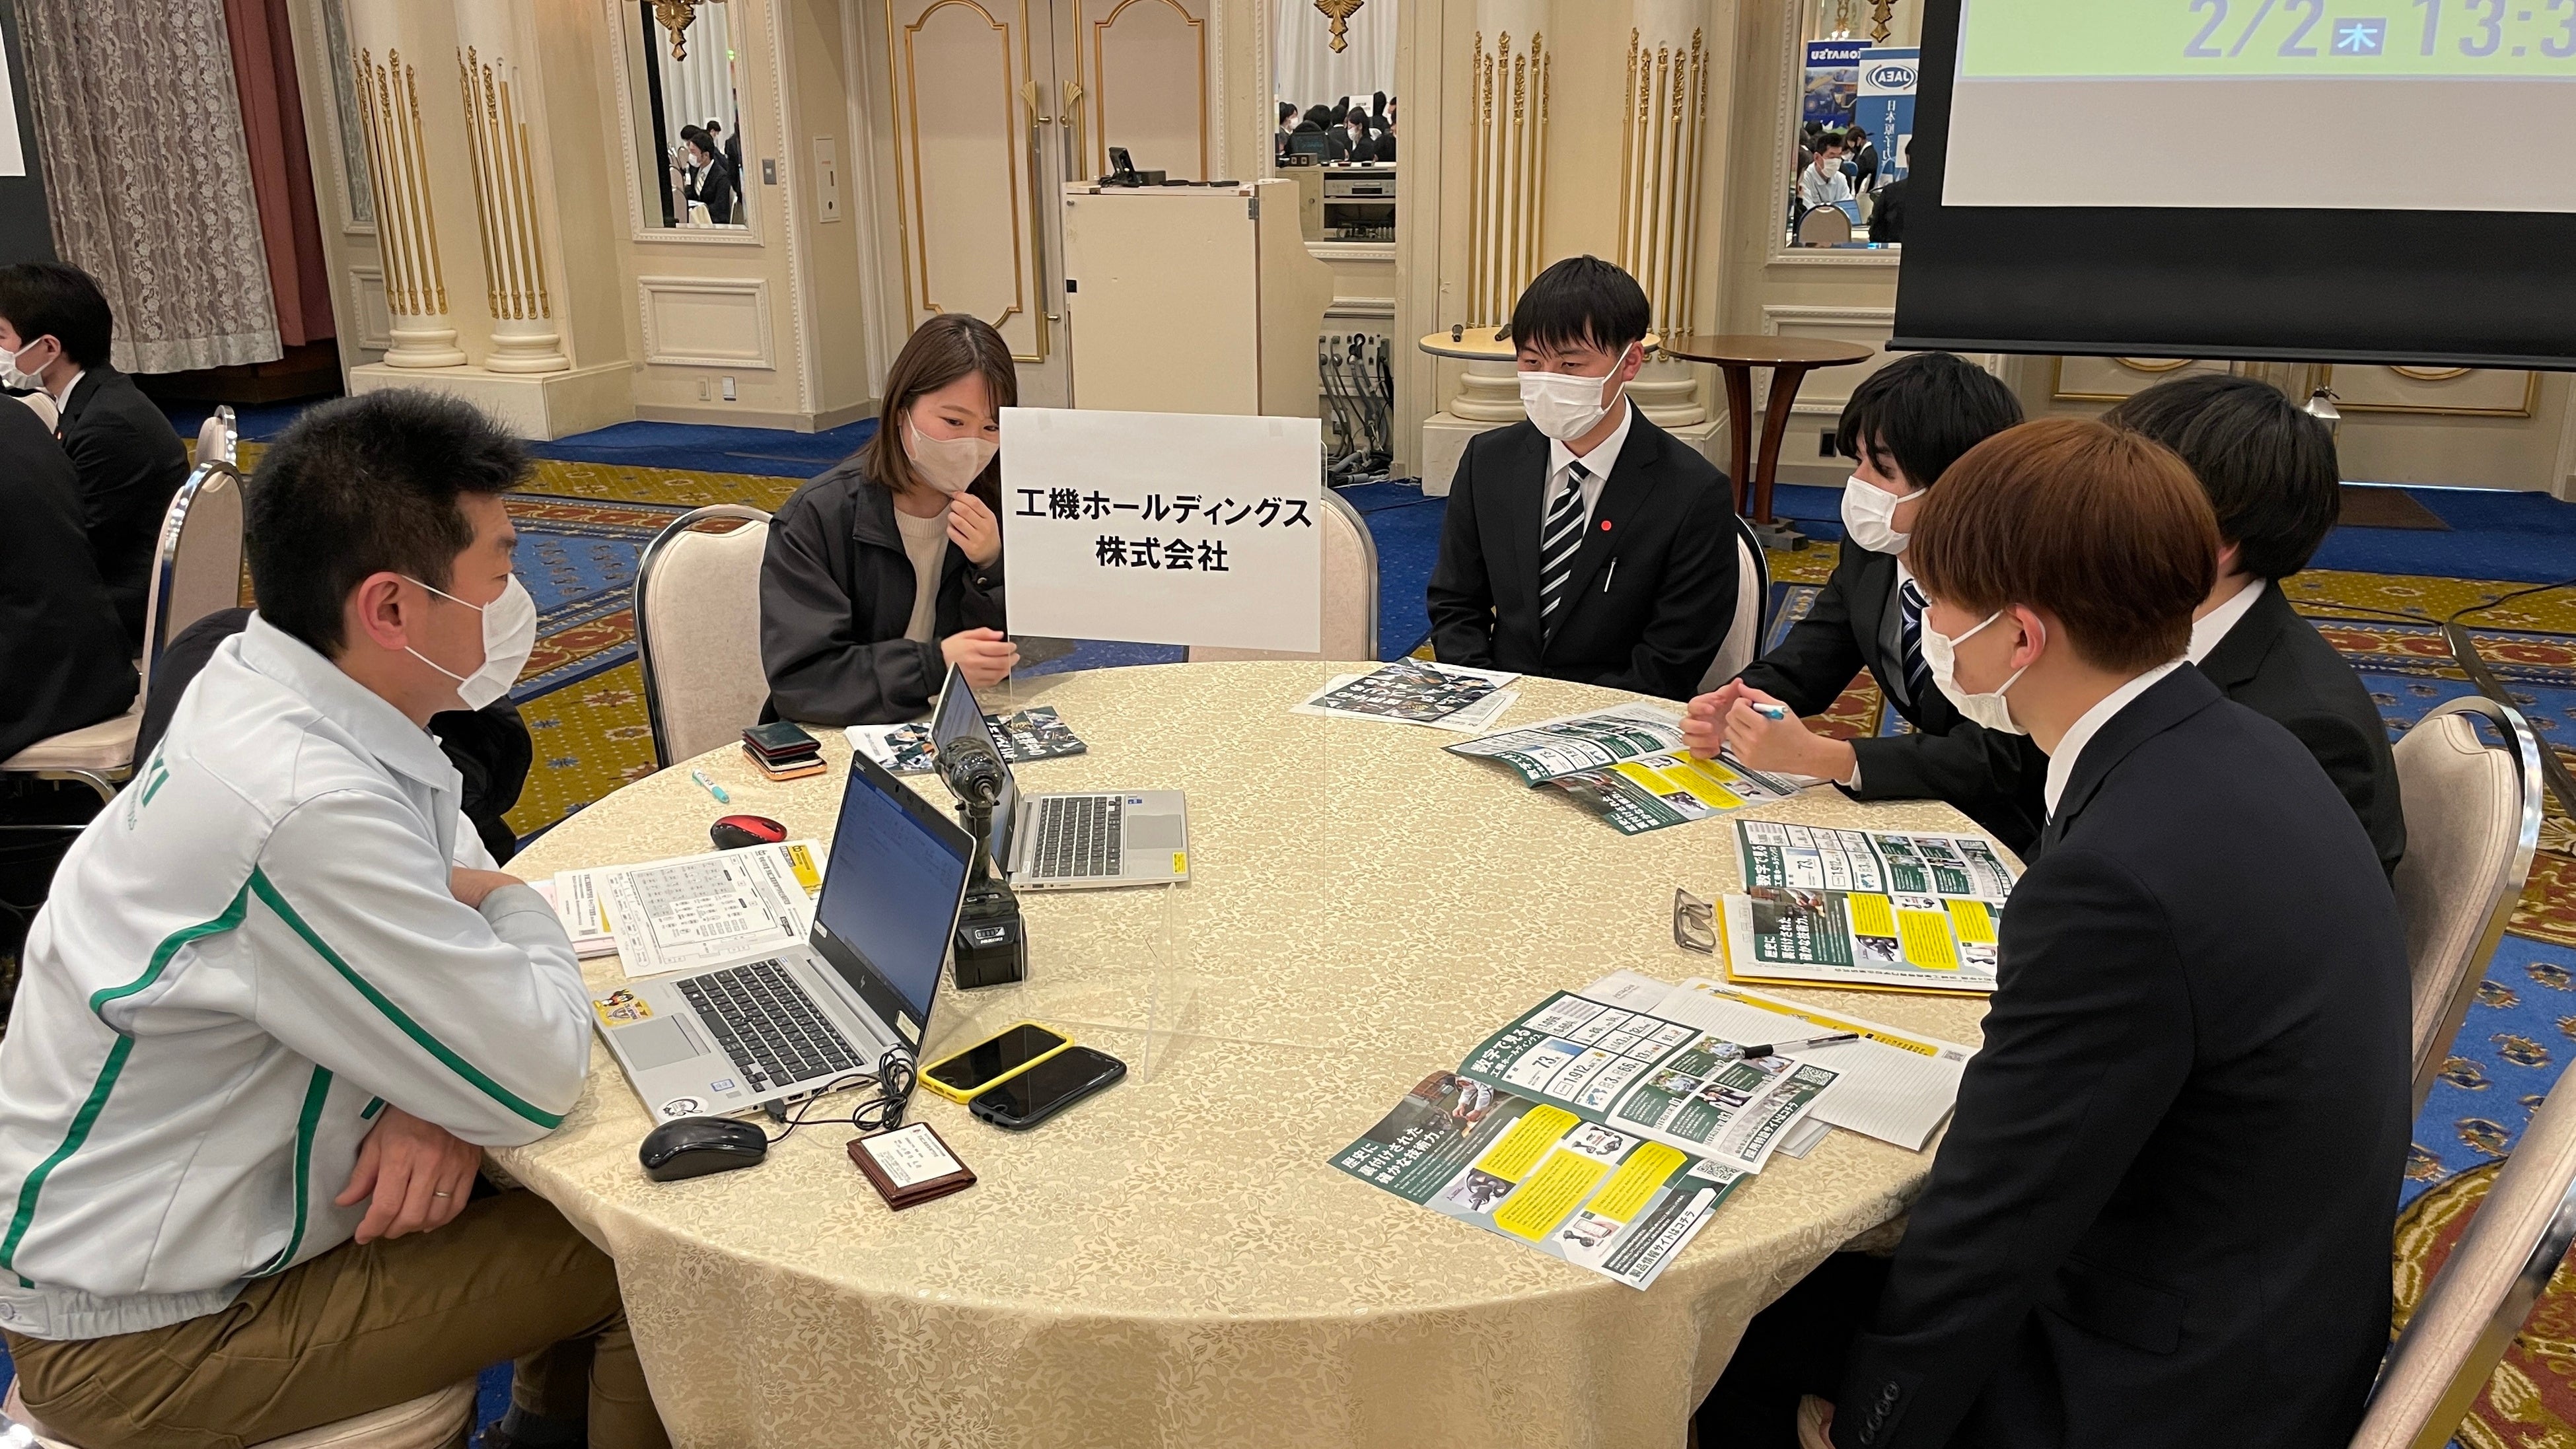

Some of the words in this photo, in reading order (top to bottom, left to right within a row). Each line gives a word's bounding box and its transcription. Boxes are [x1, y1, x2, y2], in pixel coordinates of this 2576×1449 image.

[2338, 23, 2378, 52] 木
[1015, 487, 1312, 528] 工機ホールディングス
[1095, 535, 1229, 572] 株式会社
[1013, 731, 1047, 756] 世界中の
[1752, 845, 1771, 886] 数字で見る
[1470, 1028, 1531, 1073] 数字で見る
[1341, 1143, 1378, 1169] 歴史に
[1358, 1127, 1423, 1176] 裏付けされた
[1375, 1130, 1445, 1184] 確かな技術力。
[1629, 1210, 1695, 1278] 製品情報サイトはコチラ
